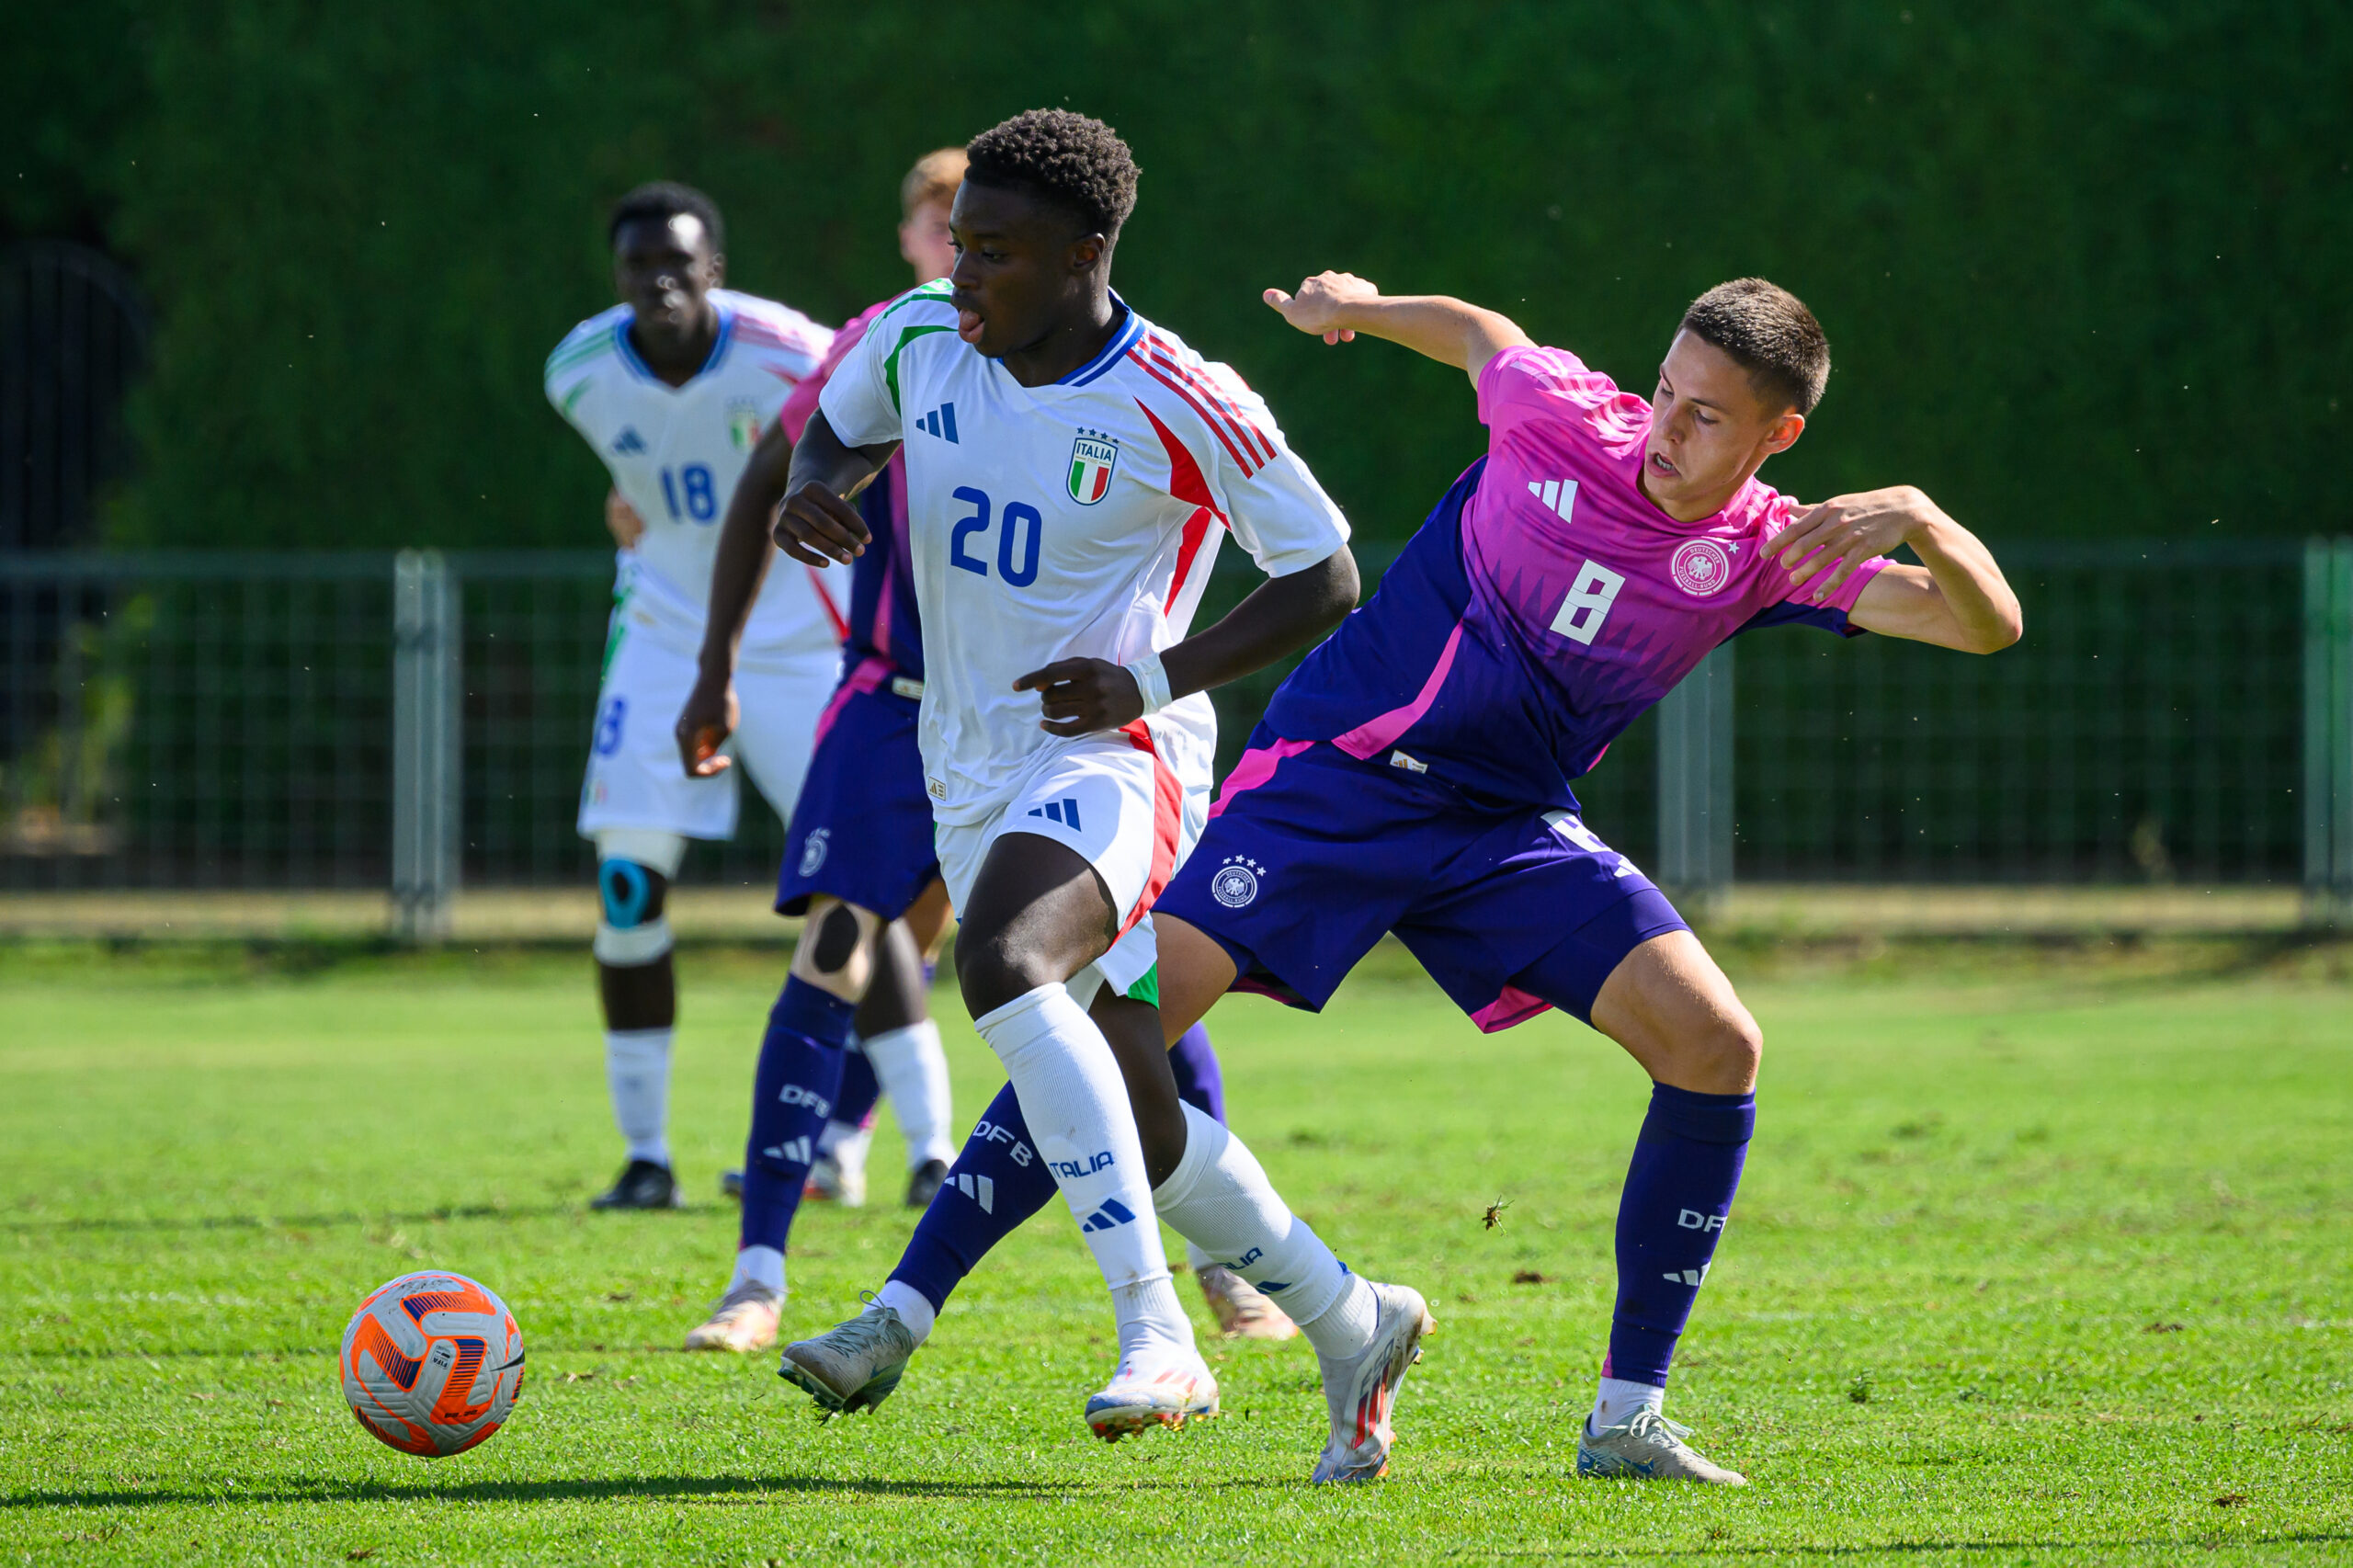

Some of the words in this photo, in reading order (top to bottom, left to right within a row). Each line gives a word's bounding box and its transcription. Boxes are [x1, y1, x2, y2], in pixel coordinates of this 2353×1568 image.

[1075, 442, 1112, 461] ITALIA
[659, 463, 719, 526] 18
[950, 486, 1042, 587] 20
[1550, 559, 1626, 645] 8
[779, 1084, 830, 1119] DFB
[972, 1120, 1033, 1167] DFB
[1677, 1209, 1728, 1234] DF
